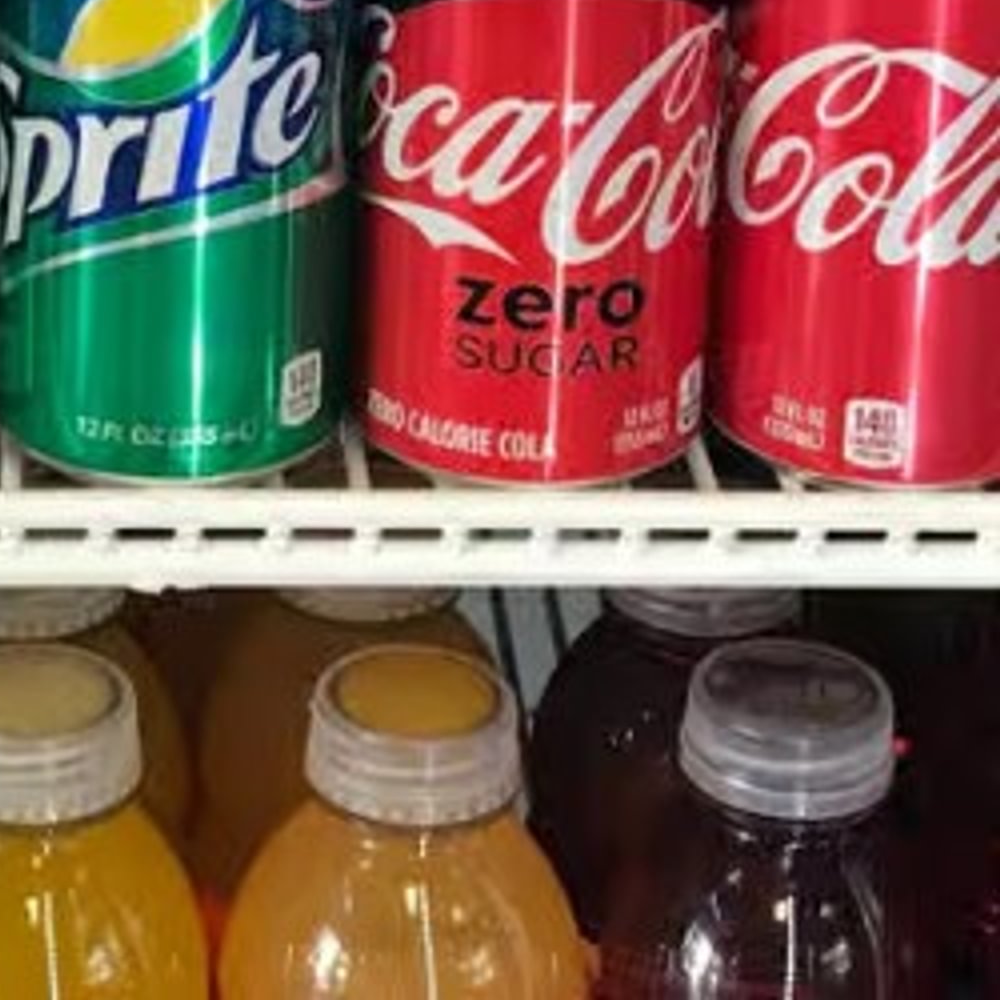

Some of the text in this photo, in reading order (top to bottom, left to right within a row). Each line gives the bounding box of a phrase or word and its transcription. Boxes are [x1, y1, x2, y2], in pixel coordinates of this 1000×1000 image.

[456, 275, 645, 332] zero
[456, 334, 639, 378] SUGAR
[408, 410, 493, 456] CALORIE
[498, 430, 556, 461] COLA
